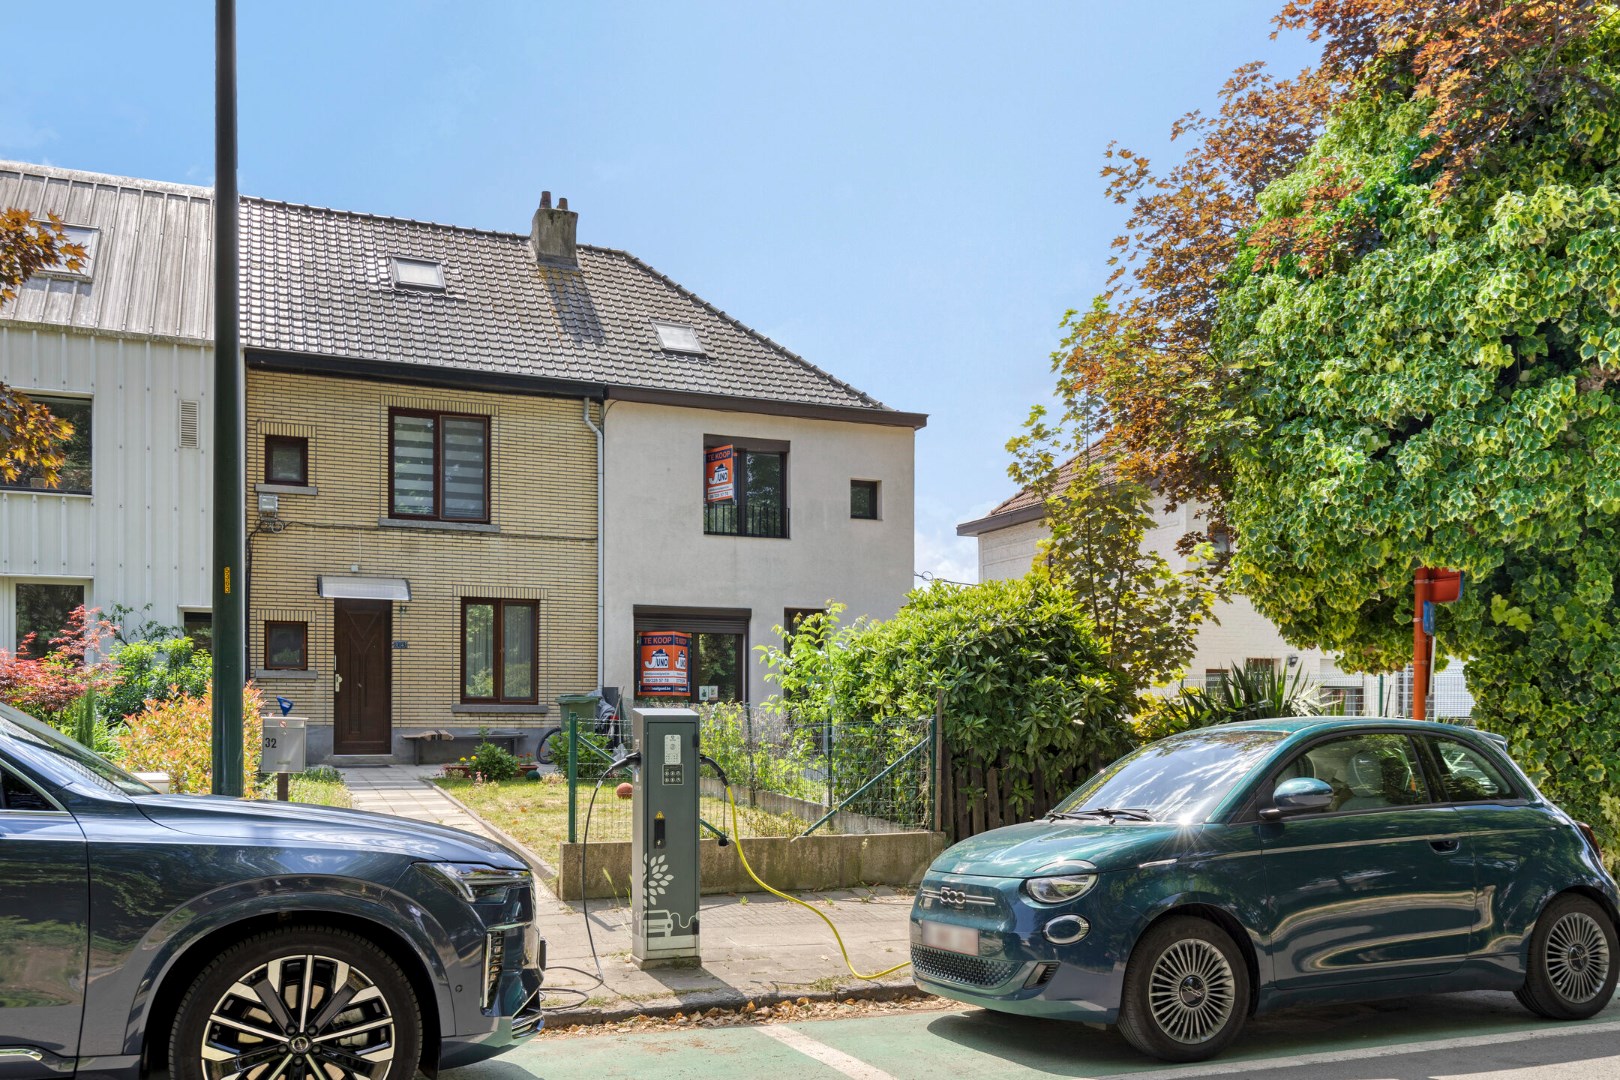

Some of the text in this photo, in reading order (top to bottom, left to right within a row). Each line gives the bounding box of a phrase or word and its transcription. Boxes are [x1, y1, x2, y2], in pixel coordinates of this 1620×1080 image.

[707, 450, 730, 462] TE KOOP
[644, 656, 669, 669] JUNO
[265, 737, 277, 749] 32
[940, 886, 966, 905] 500
